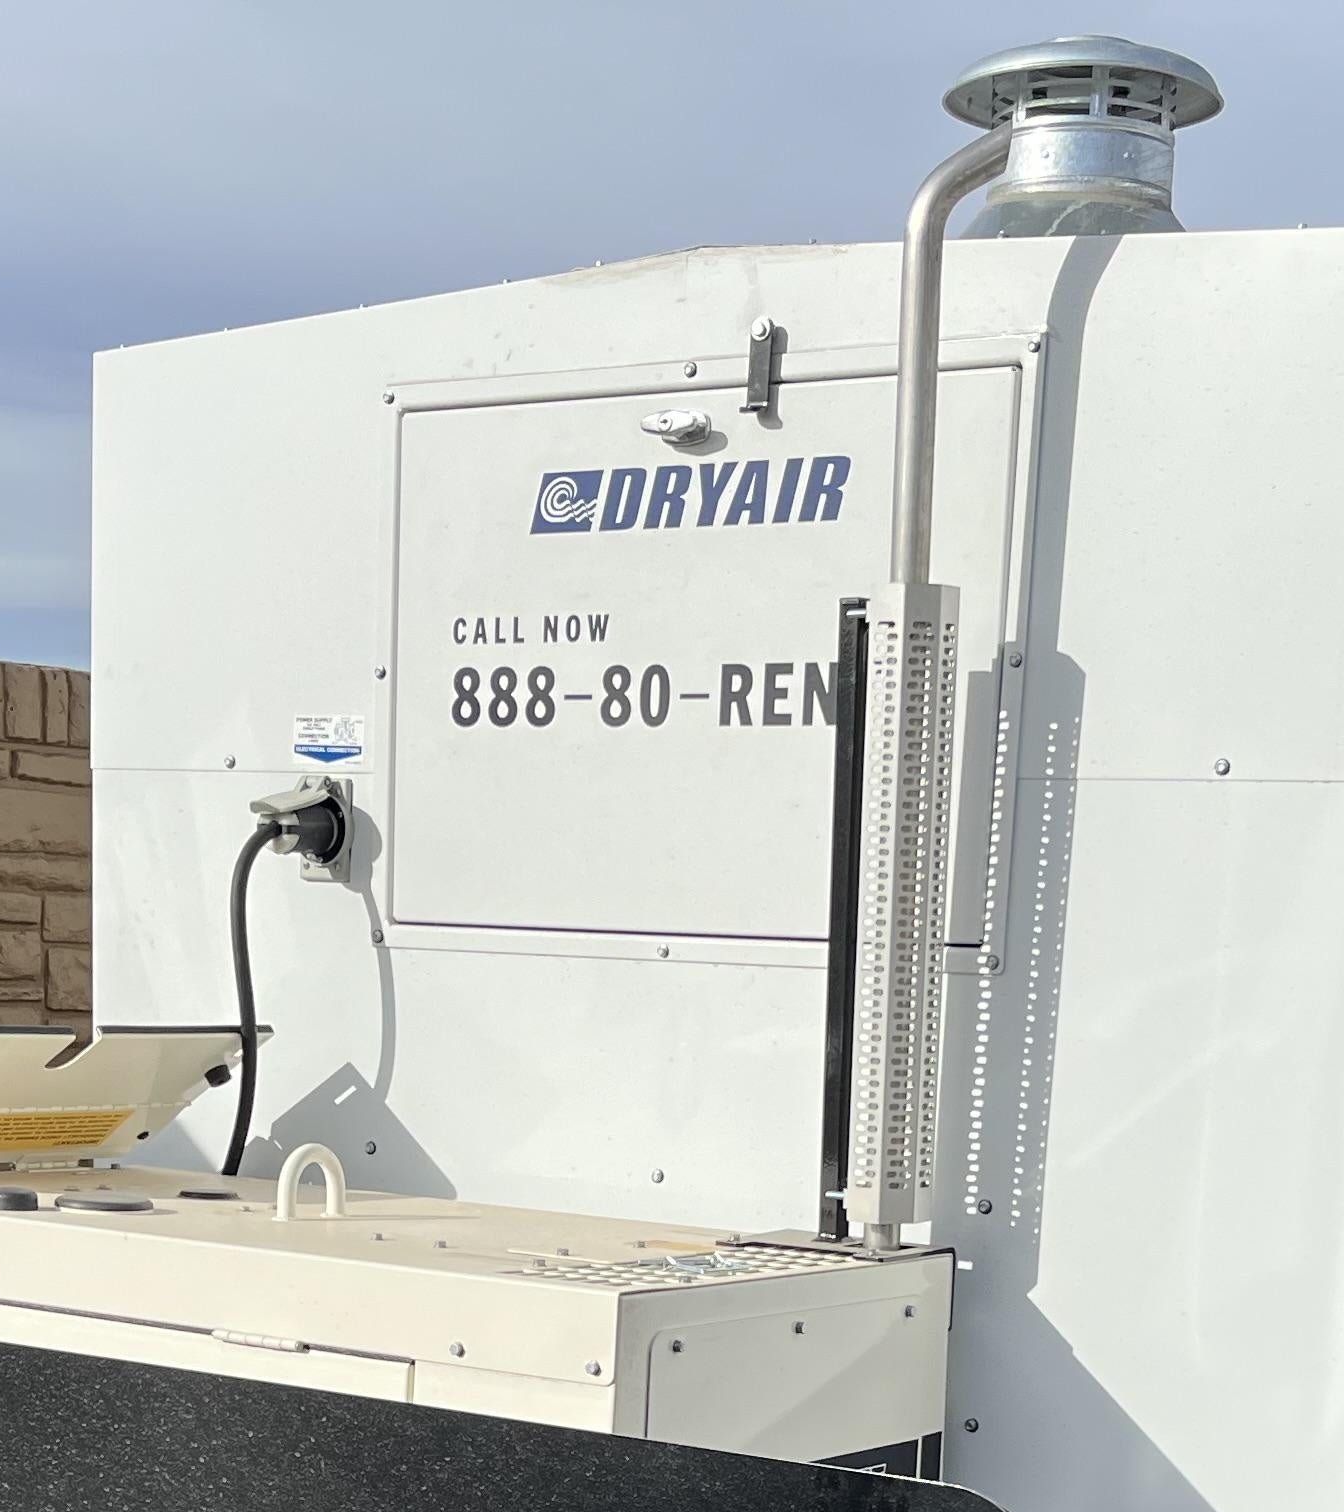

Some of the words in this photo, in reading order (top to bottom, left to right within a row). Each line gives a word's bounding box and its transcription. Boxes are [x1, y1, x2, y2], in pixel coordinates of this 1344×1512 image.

[598, 455, 852, 532] DRYAIR
[452, 616, 525, 645] CALL
[542, 614, 610, 643] NOW
[451, 662, 840, 728] 888-80-REN
